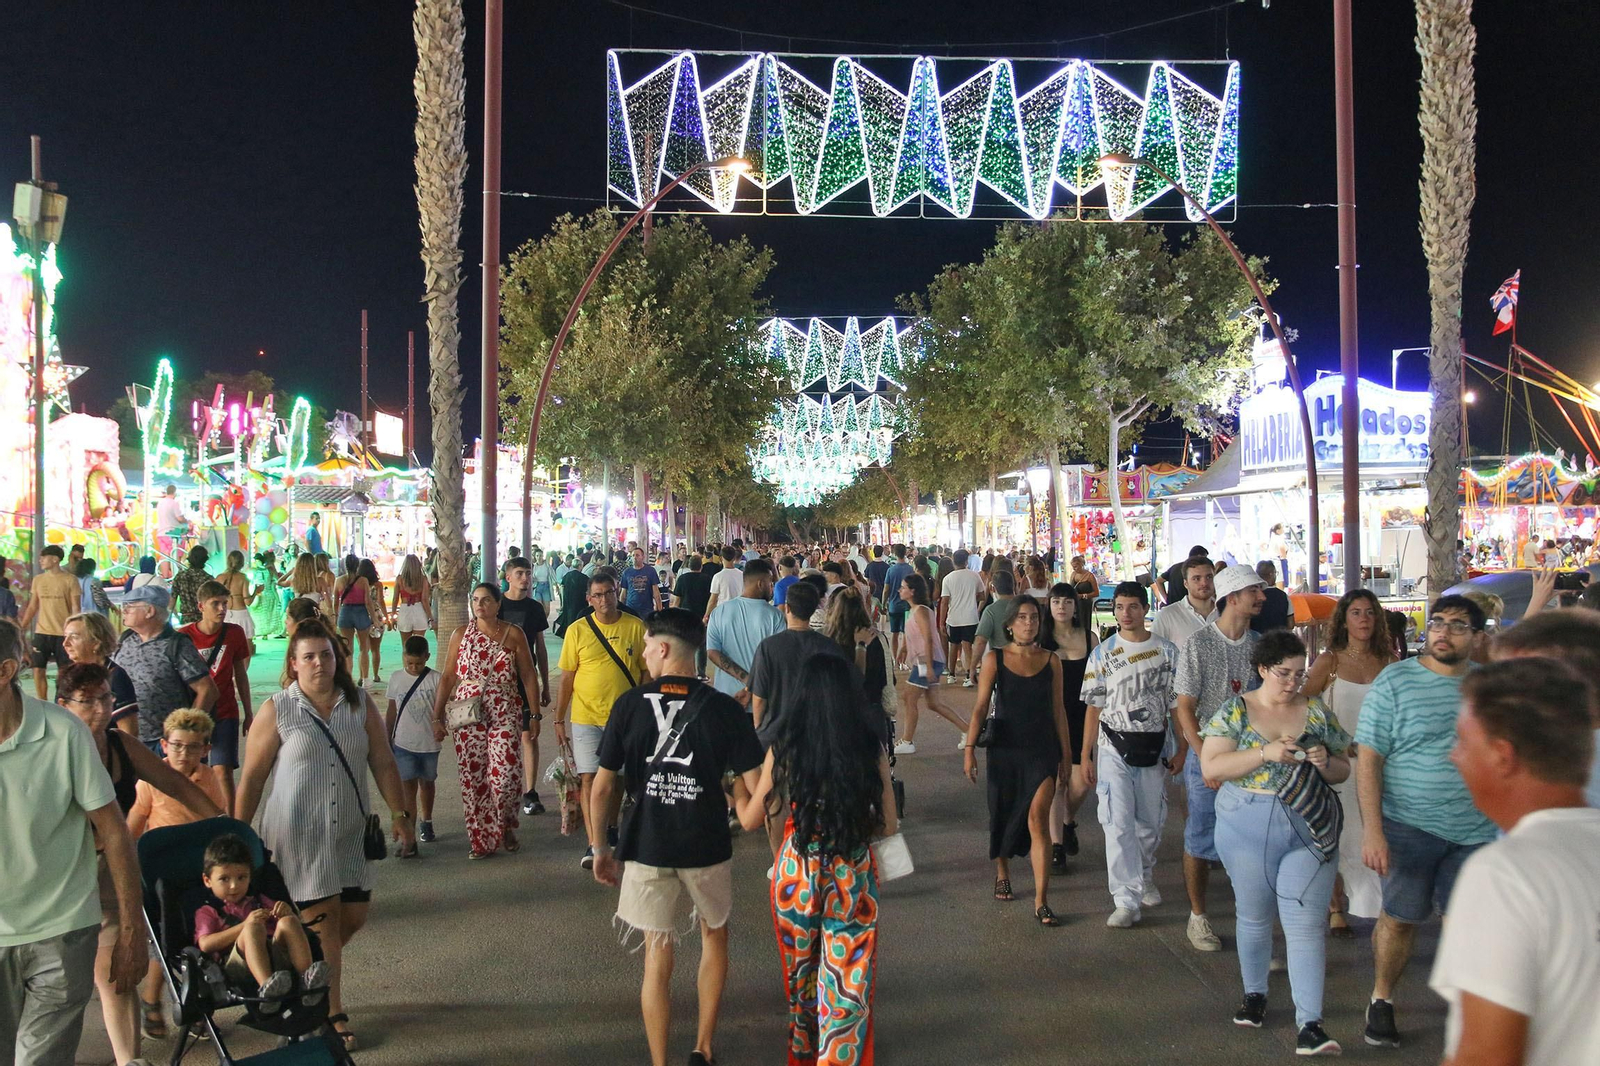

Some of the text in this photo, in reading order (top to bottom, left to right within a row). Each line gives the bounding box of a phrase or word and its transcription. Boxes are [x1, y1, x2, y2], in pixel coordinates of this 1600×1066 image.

[1315, 395, 1426, 436] Hados
[1243, 413, 1304, 466] HELADERIA
[668, 773, 696, 785] Vuitton
